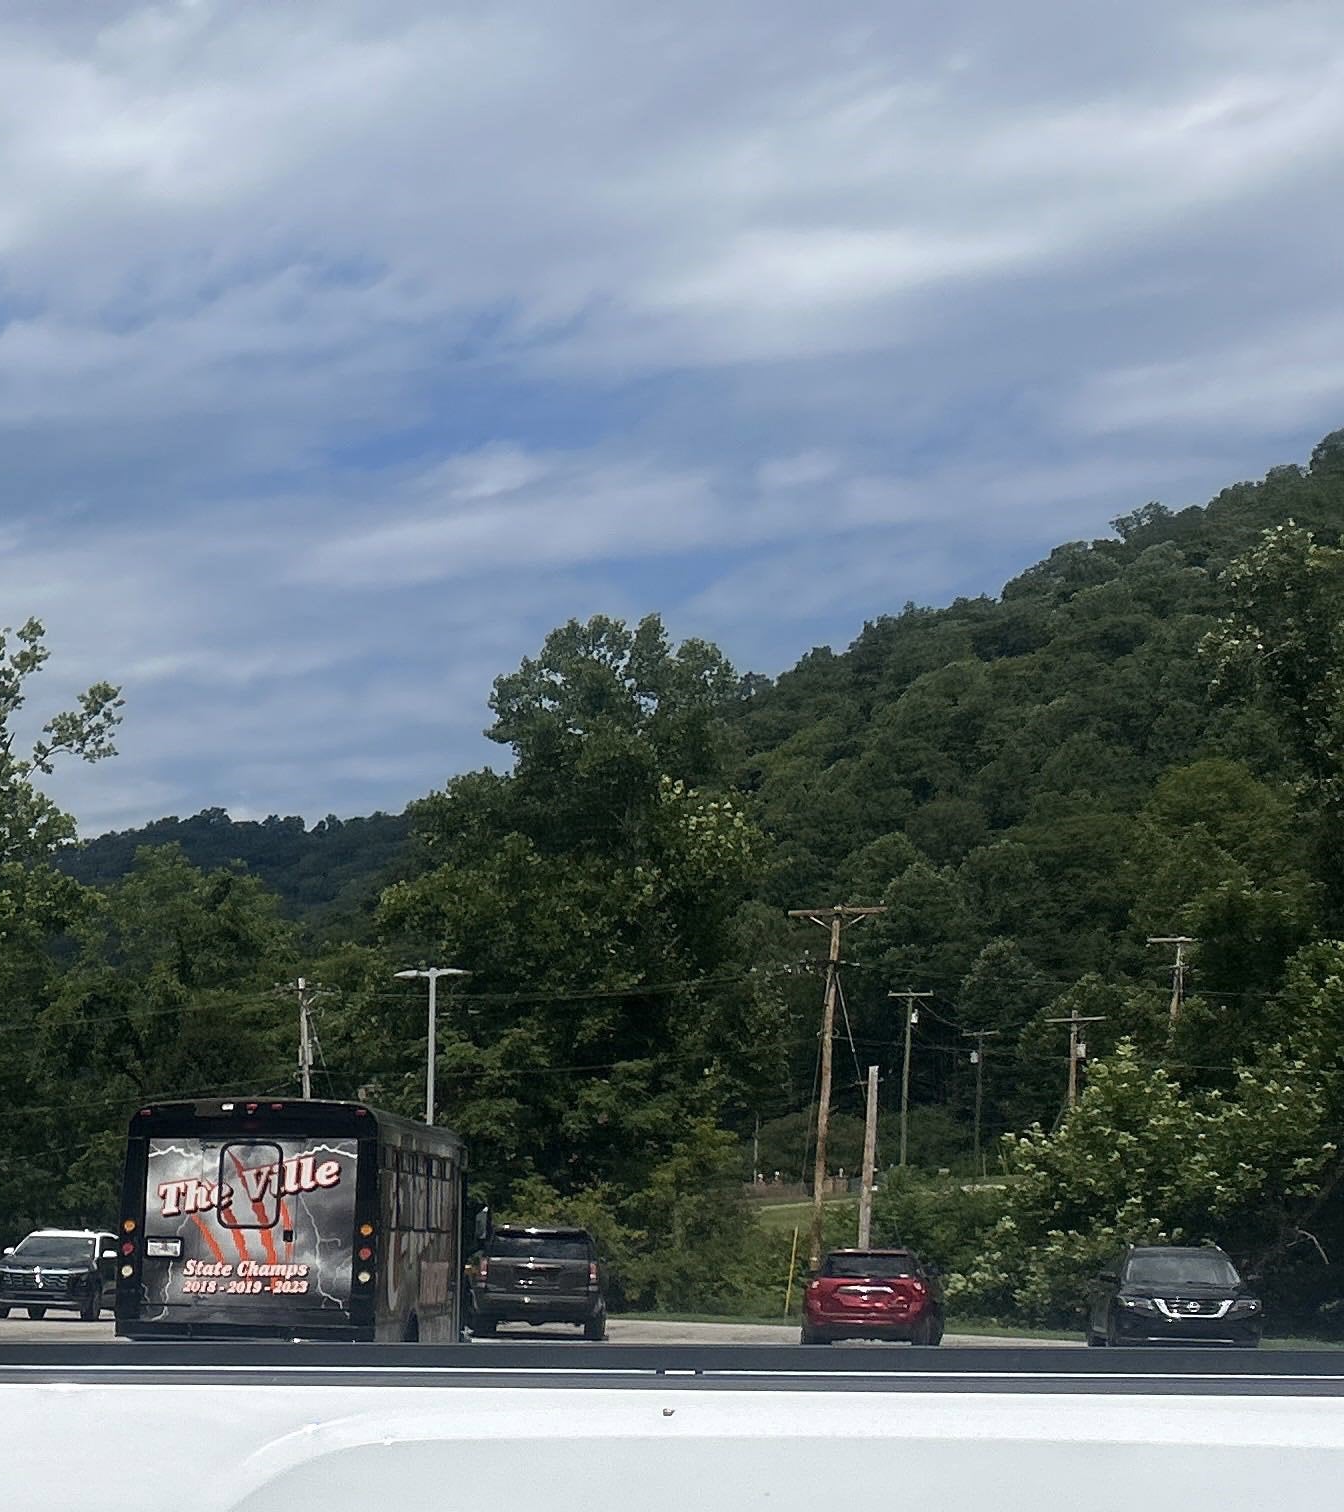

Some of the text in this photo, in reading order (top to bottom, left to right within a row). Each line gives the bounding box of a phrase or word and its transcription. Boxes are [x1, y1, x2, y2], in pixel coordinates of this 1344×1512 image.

[158, 1155, 342, 1217] The Ville
[183, 1258, 310, 1280] State Champs
[182, 1280, 218, 1294] 2018
[226, 1280, 263, 1294] 2019
